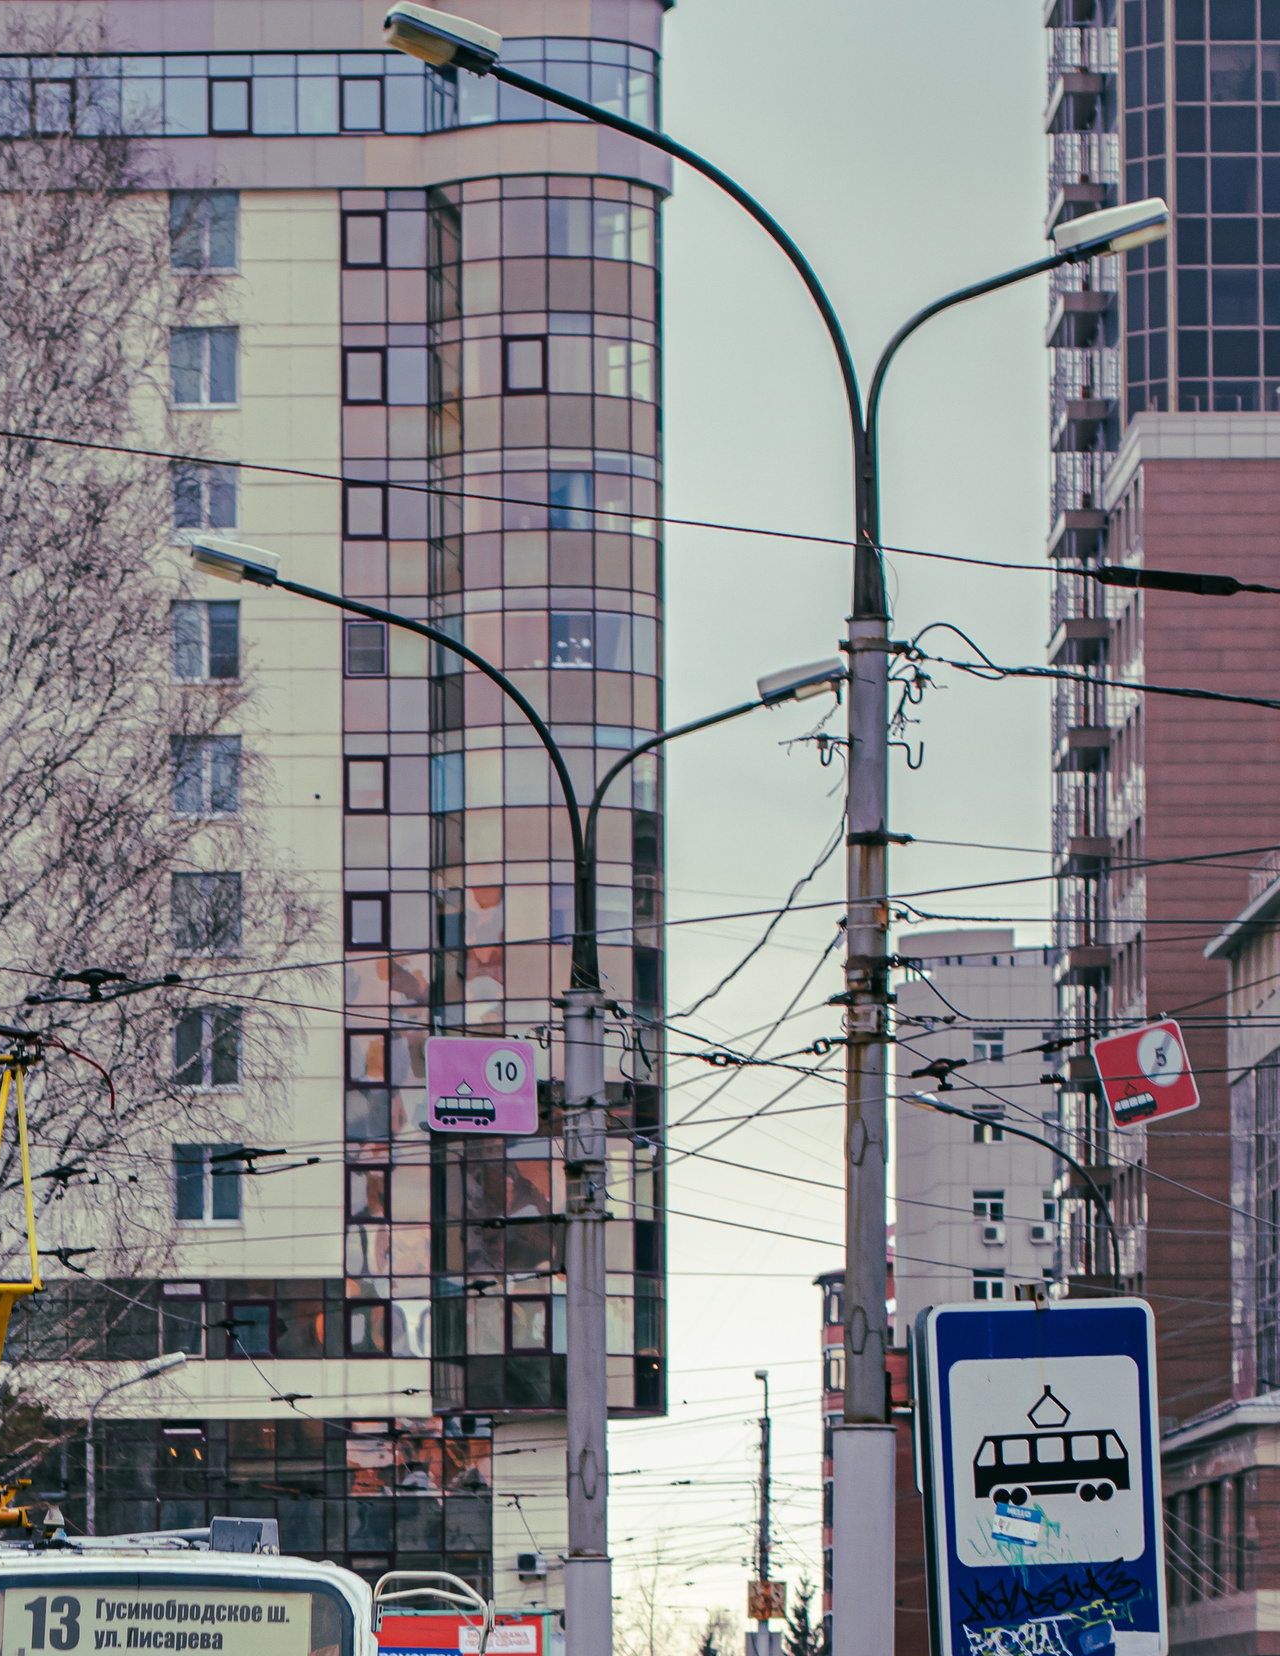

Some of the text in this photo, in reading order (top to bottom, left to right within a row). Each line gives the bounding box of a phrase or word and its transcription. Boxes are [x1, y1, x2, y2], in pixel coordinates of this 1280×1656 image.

[1154, 1047, 1168, 1067] 5
[494, 1060, 518, 1082] 10
[24, 1595, 82, 1651] 13
[95, 1598, 290, 1625] Гусинобродское ш.
[94, 1627, 224, 1651] ул. Писарева
